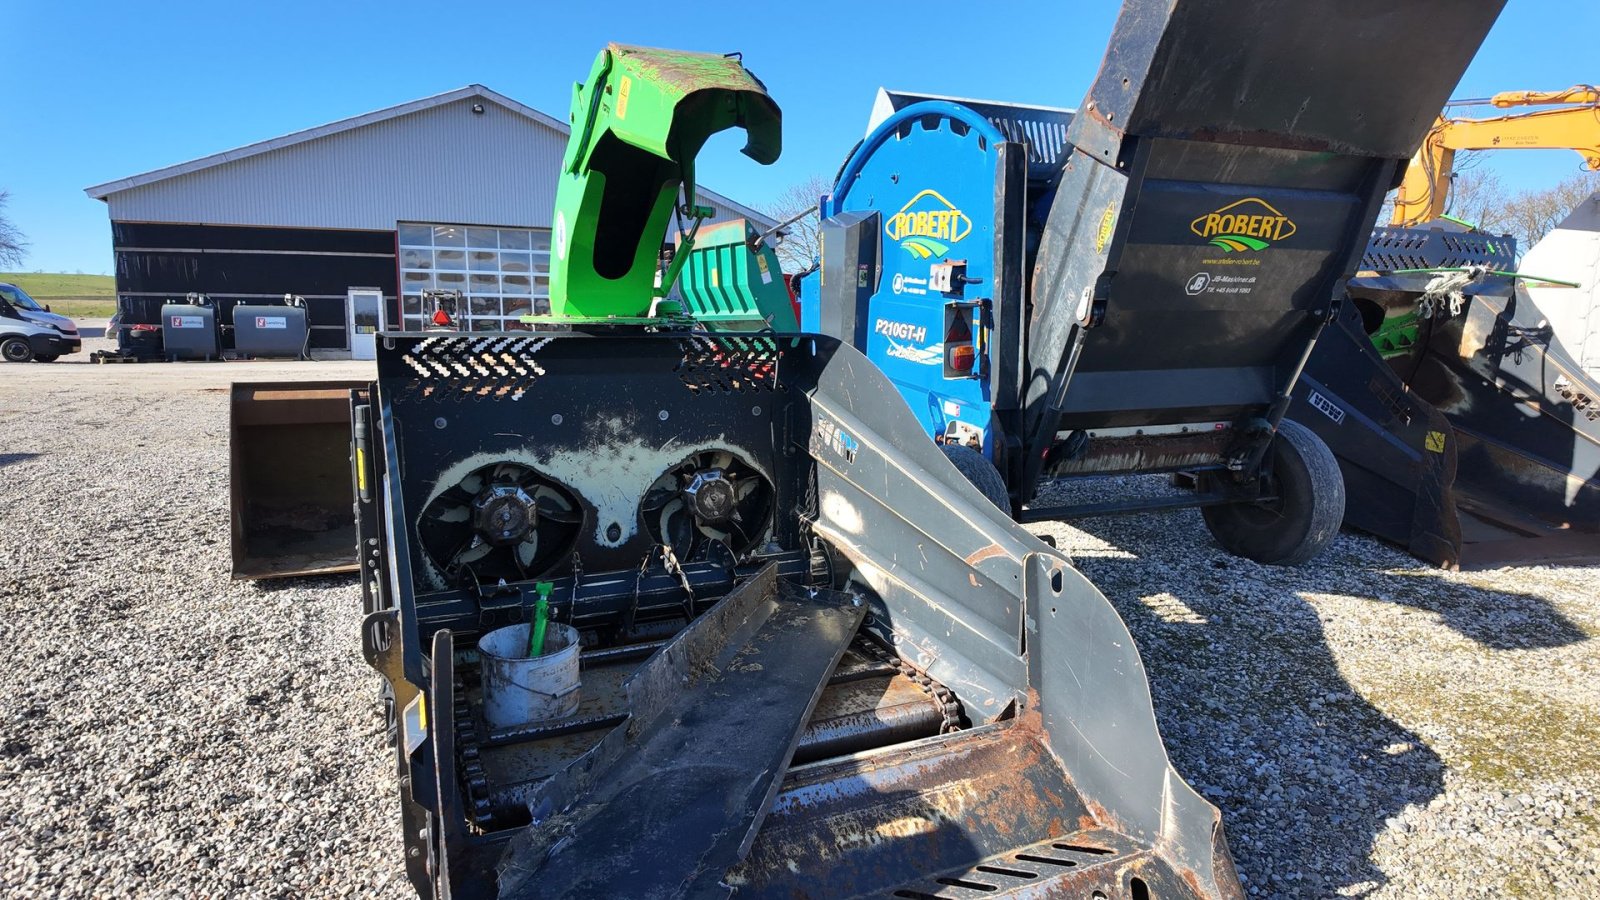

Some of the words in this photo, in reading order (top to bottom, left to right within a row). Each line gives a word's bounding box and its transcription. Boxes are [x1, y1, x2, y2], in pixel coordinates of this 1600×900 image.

[894, 209, 962, 243] ROBERT
[1097, 208, 1114, 249] ROBERT
[1203, 213, 1288, 241] ROBERT
[1189, 276, 1206, 291] JB
[875, 318, 927, 343] P210GT-H
